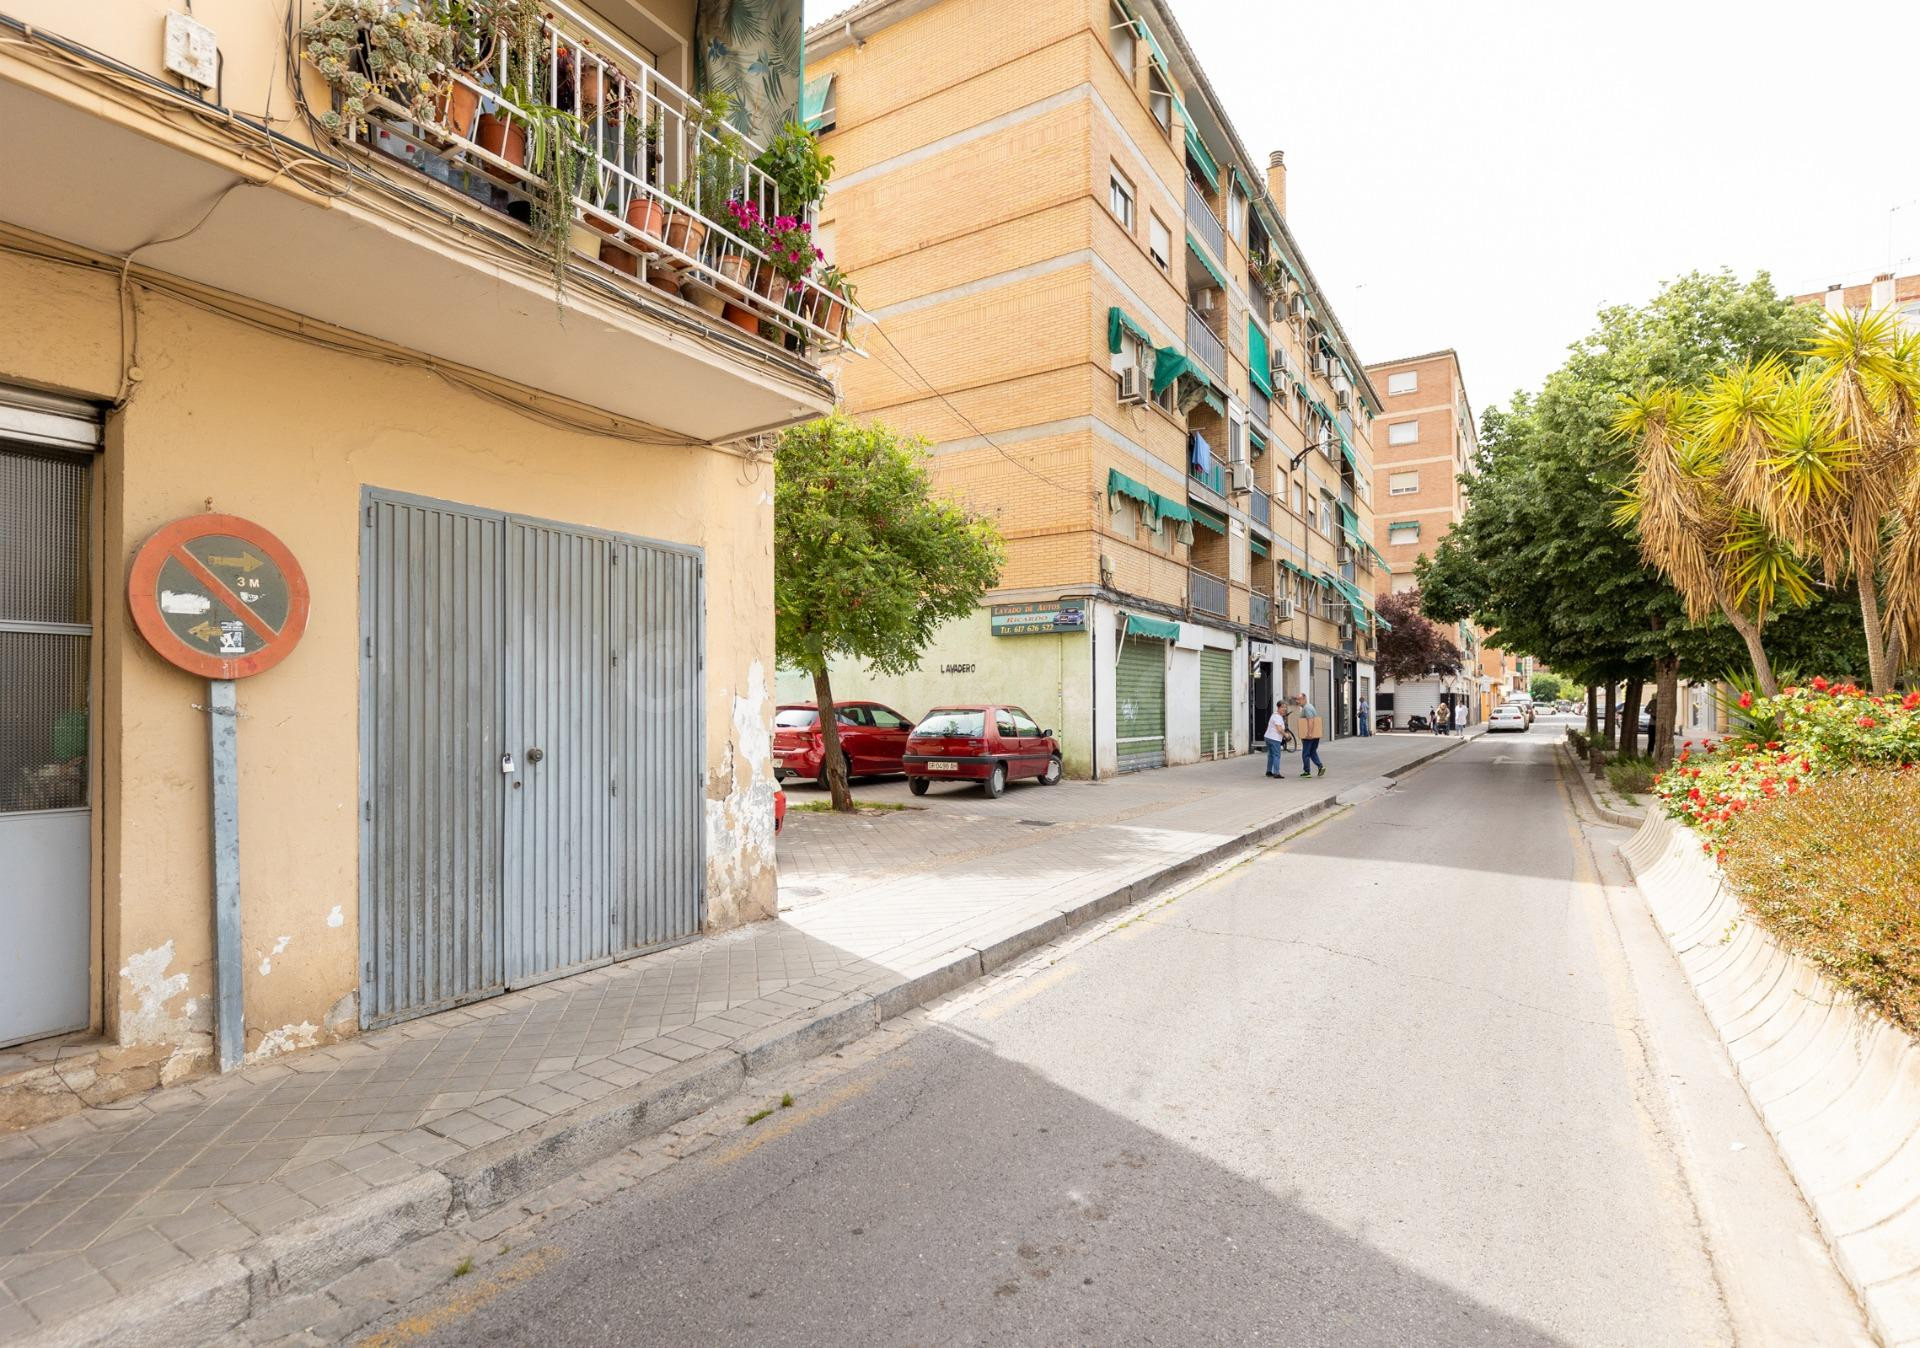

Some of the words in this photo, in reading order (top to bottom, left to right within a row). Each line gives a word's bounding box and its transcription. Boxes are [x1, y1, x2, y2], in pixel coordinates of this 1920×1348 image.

[237, 577, 245, 587] 3
[249, 578, 260, 588] M
[995, 607, 1021, 615] LAVADO
[1037, 603, 1060, 612] AUTOS
[1007, 615, 1048, 623] RICARDO
[940, 664, 976, 674] LAVADERO
